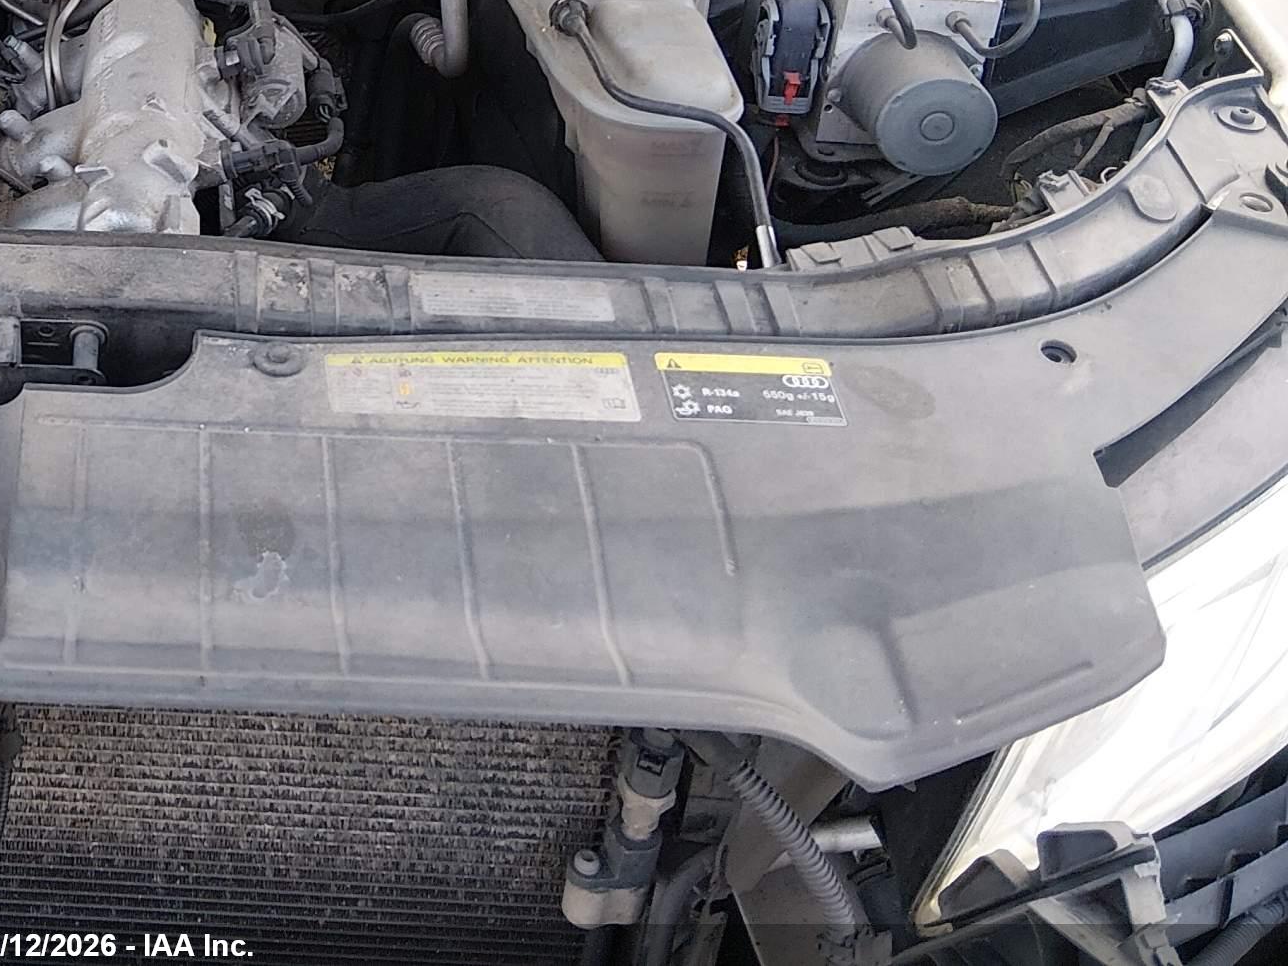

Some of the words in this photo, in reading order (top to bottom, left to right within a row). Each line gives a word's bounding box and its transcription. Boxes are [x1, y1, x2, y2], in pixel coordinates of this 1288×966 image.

[369, 356, 434, 364] ACHTUNG
[442, 356, 510, 364] WARNING
[517, 356, 593, 365] ATTENTION
